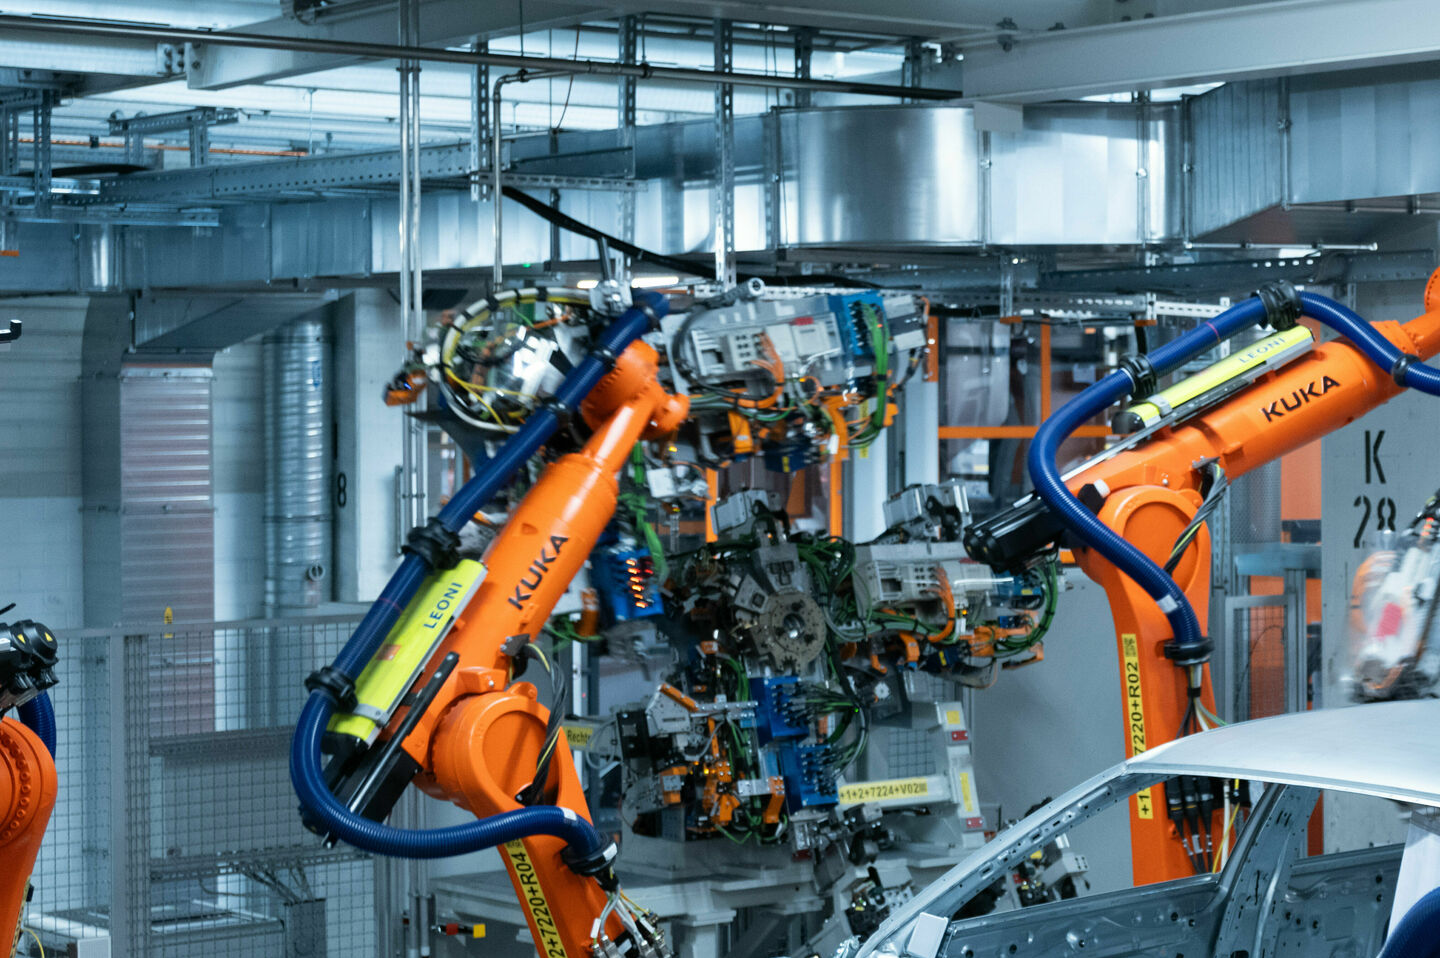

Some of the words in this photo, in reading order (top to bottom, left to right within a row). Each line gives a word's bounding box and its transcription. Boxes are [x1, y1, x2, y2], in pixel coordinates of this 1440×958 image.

[1238, 337, 1286, 364] LEONI
[1262, 375, 1341, 422] KUKA
[1365, 430, 1387, 484] K
[508, 535, 569, 610] KUKA
[423, 582, 463, 629] LEONI
